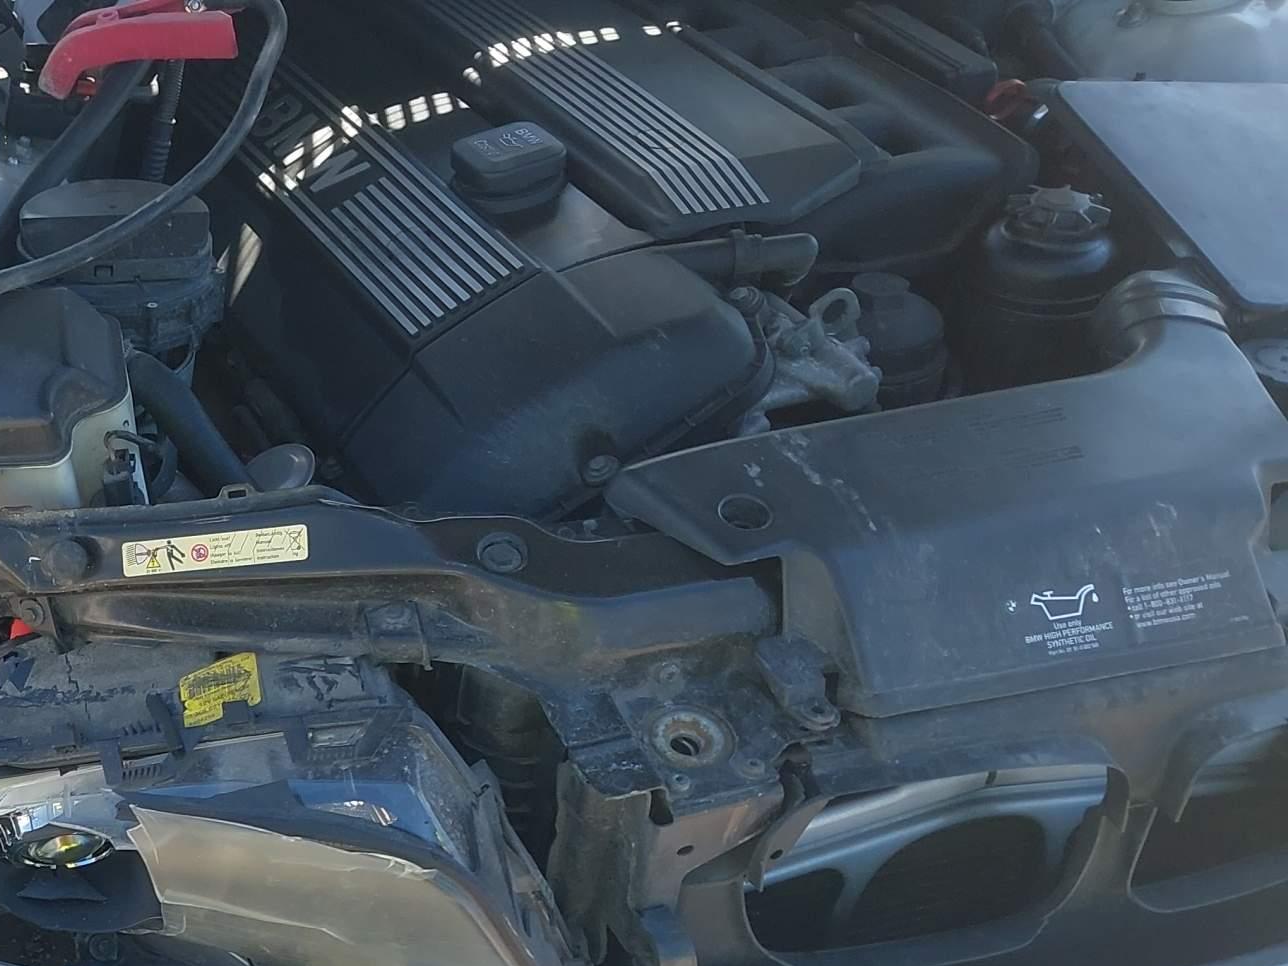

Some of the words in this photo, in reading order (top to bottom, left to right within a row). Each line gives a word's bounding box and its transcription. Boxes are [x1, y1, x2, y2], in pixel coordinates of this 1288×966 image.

[251, 93, 372, 193] BMW
[515, 127, 544, 145] BMW
[1133, 585, 1151, 593] more
[1024, 633, 1043, 644] BMW
[1043, 629, 1062, 641] HIGH
[1062, 621, 1114, 638] PERFORMANCE
[1053, 621, 1067, 630] Use
[1067, 619, 1082, 629] only
[1046, 634, 1085, 649] SYNTHETIC
[1084, 633, 1097, 642] OIL
